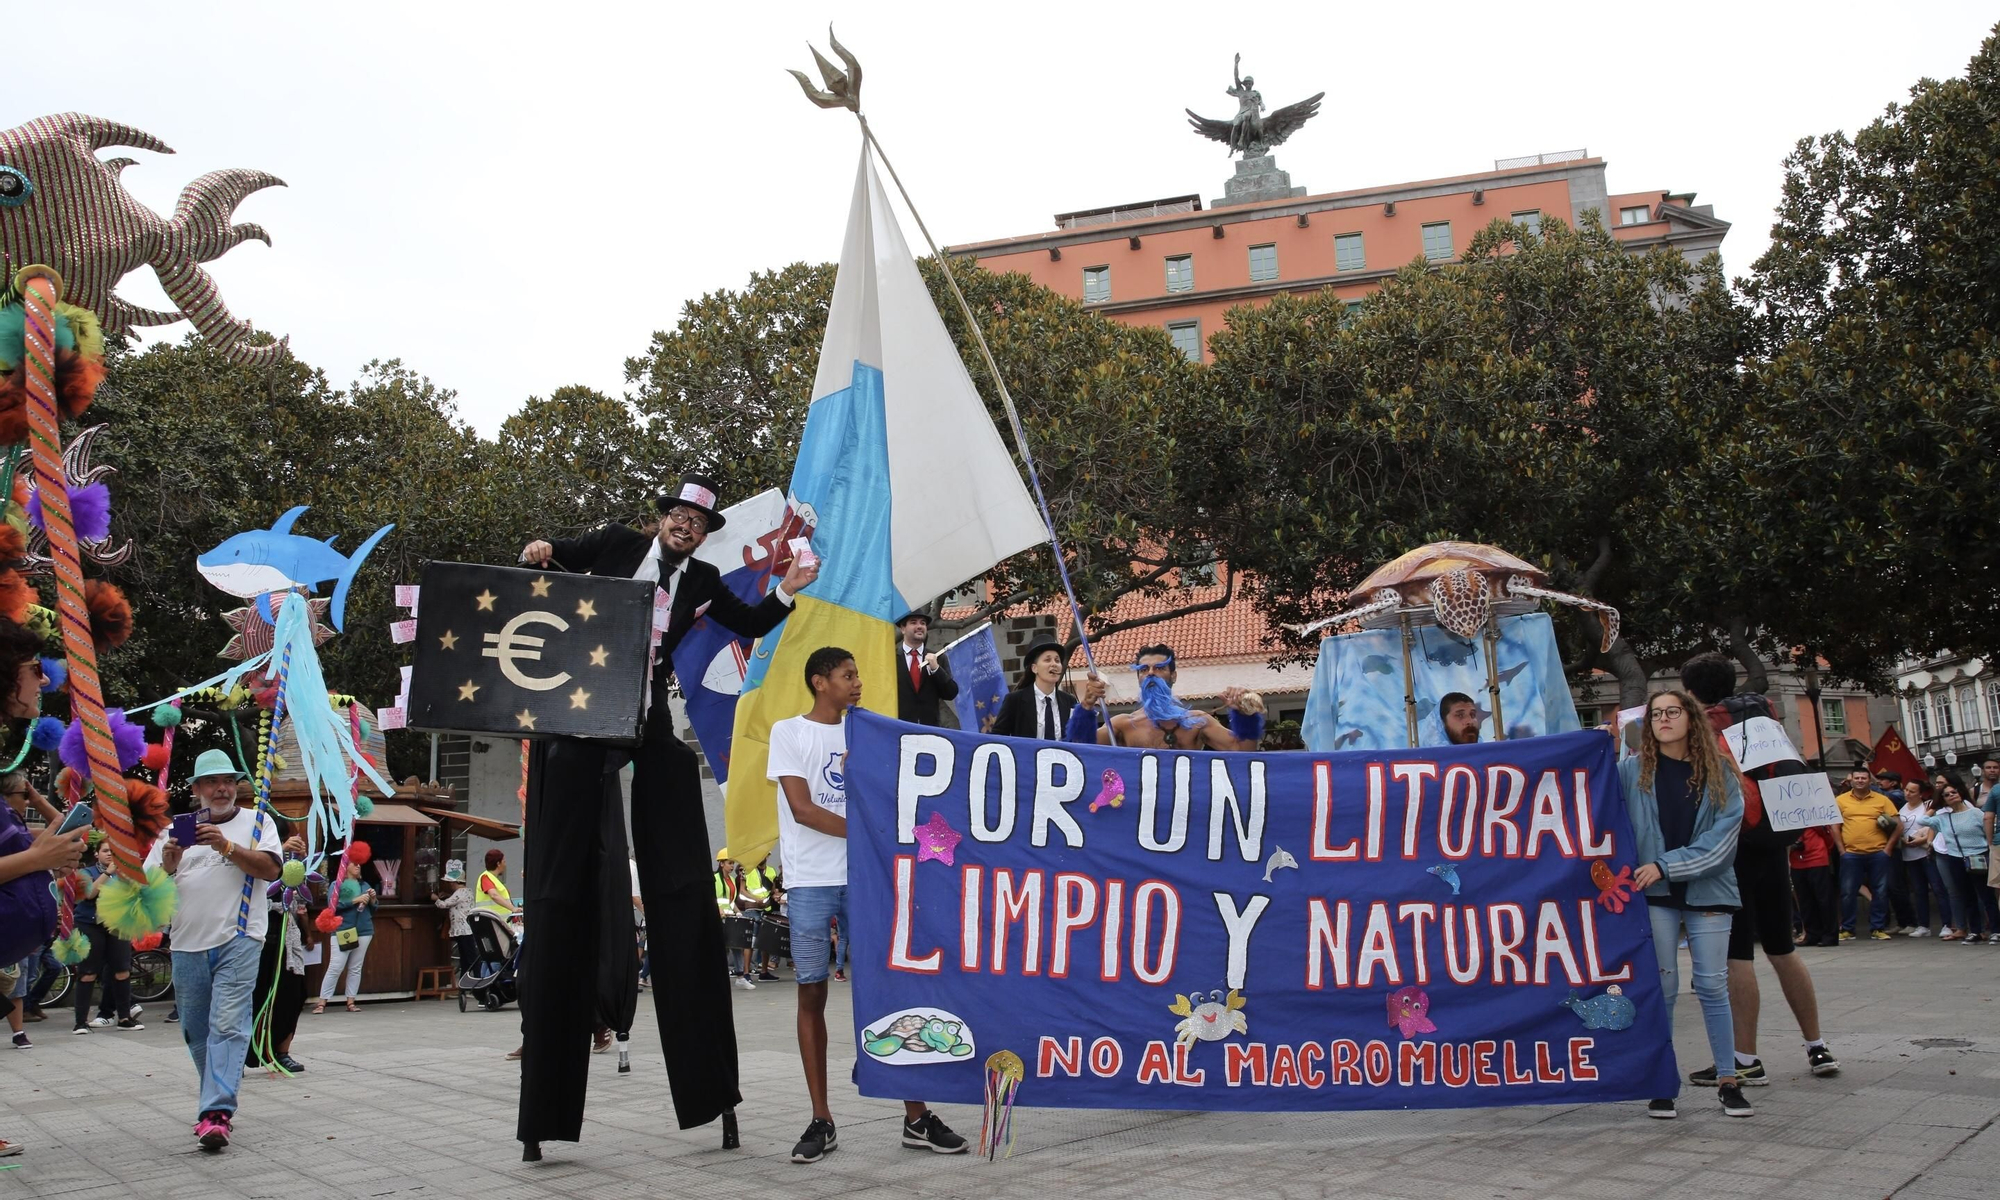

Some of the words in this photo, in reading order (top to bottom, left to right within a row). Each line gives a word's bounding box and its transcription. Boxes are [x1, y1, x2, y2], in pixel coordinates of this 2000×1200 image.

[898, 734, 1085, 847] POR
[1138, 756, 1267, 862] UN
[1311, 760, 1615, 861] LITORAL
[1778, 781, 1803, 801] NO
[888, 855, 1181, 985] LIMPIO
[1213, 892, 1269, 992] Y
[1306, 896, 1634, 992] NATURAL
[1037, 1035, 1124, 1079] NO
[1138, 1039, 1206, 1088] AL
[1225, 1037, 1599, 1088] MACROMUELLE
